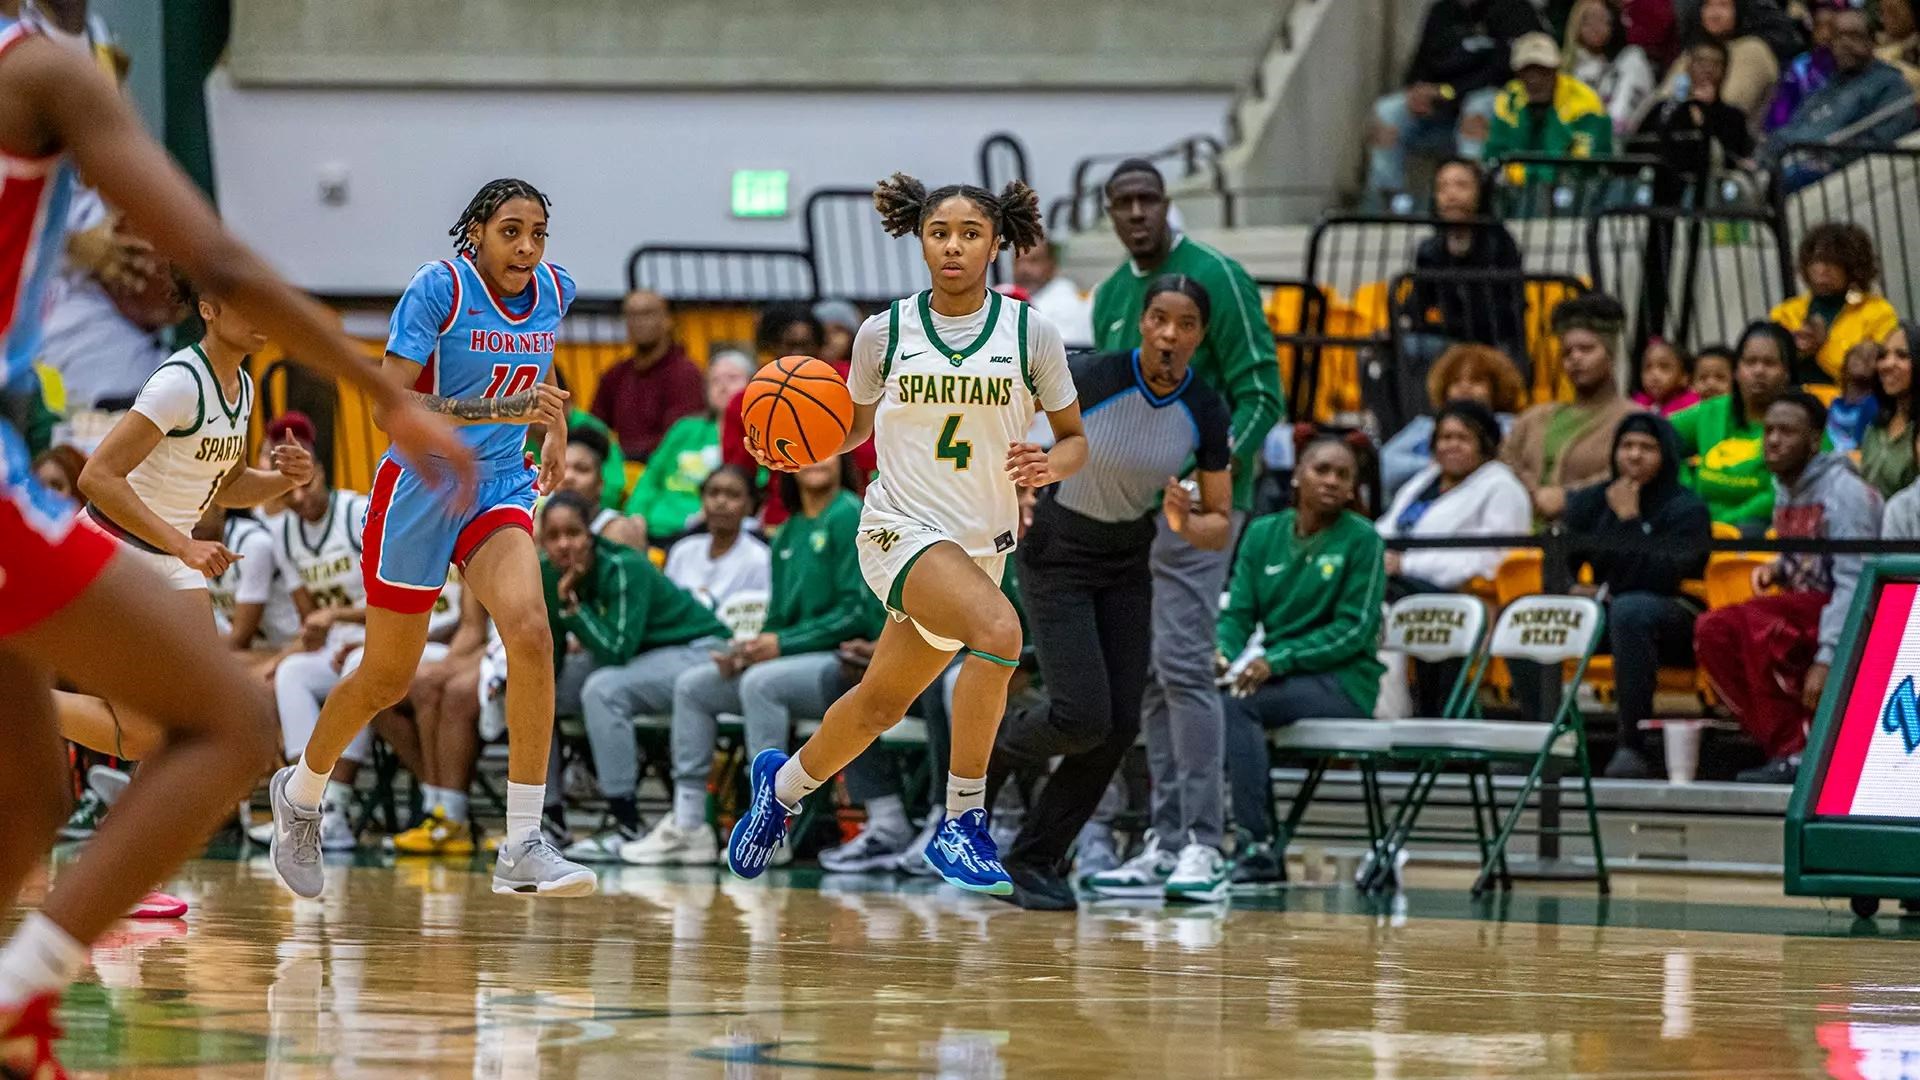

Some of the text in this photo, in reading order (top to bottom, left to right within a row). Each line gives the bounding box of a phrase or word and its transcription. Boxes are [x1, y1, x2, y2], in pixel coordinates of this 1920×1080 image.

[469, 329, 555, 354] HORNETS
[480, 364, 540, 399] 10
[898, 375, 1013, 406] SPARTANS
[935, 413, 973, 472] 4
[1393, 608, 1467, 628] NORFOLK
[1509, 608, 1583, 630] NORFOLK
[1403, 629, 1451, 645] STATE
[1520, 629, 1568, 645] STATE
